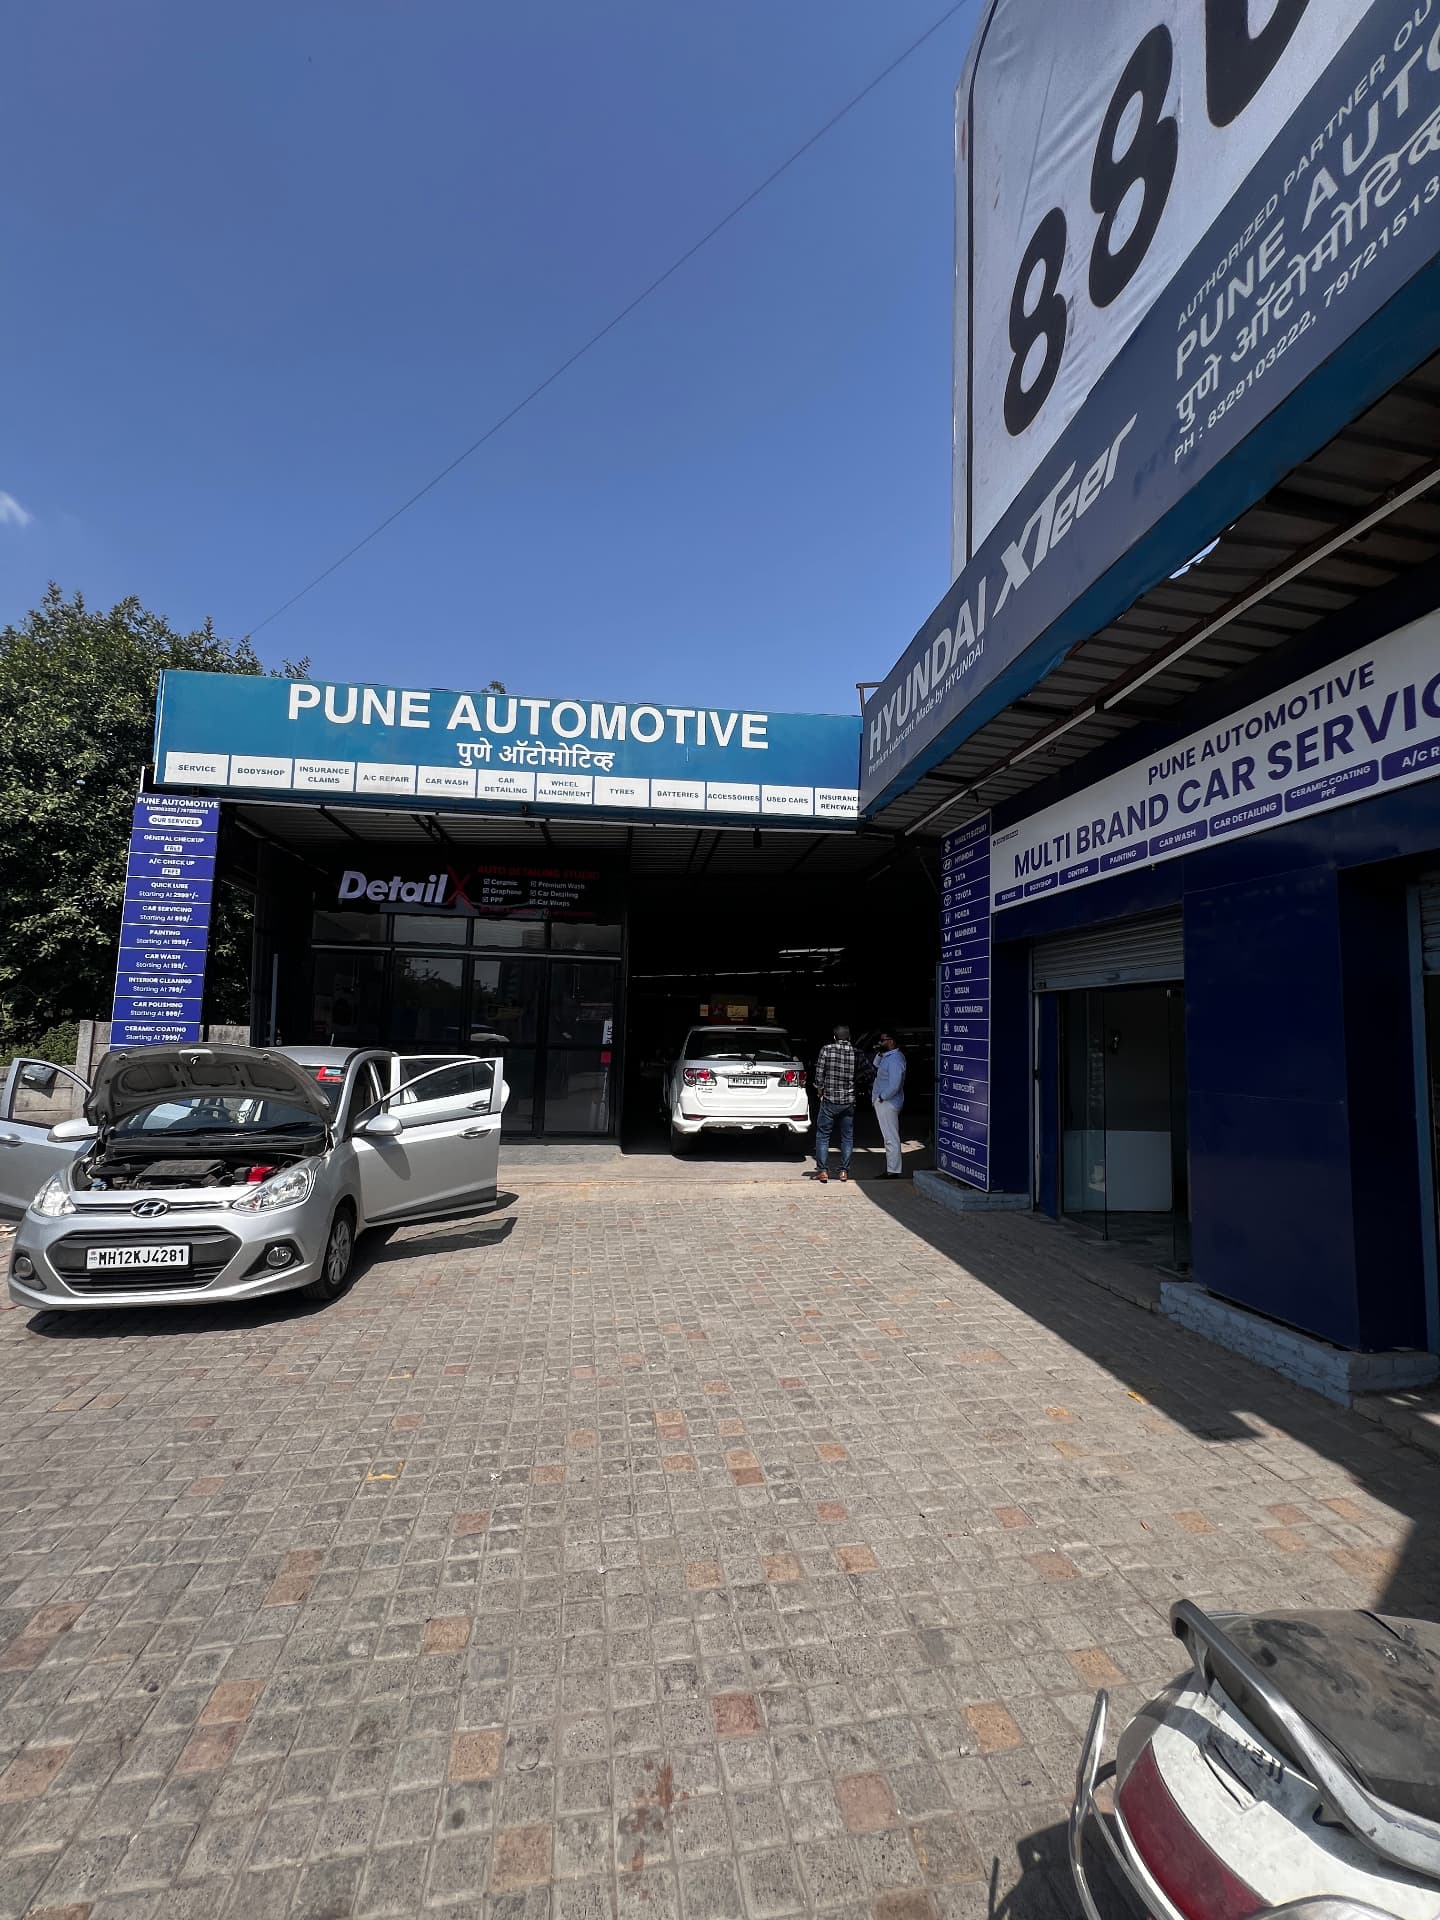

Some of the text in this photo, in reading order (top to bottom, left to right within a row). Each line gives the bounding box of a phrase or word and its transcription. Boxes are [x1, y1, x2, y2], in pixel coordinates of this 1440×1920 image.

[1177, 193, 1278, 331] AUTHORIZED
[1284, 54, 1386, 196] PARTNER
[1176, 23, 1440, 381] PUNE AUT
[1004, 0, 1311, 437] 88
[1174, 431, 1195, 465] PH
[1207, 310, 1317, 429] 8329103222,
[1176, 353, 1222, 434] पुणे
[869, 576, 987, 760] HYUNDAI
[916, 703, 935, 724] Made
[935, 687, 944, 704] by
[945, 639, 984, 689] HYUNDAI
[288, 683, 769, 750] PUNE AUTOMOTIVE
[1148, 660, 1375, 785] PUNE AUTOMOTIVE
[456, 738, 615, 772] पुणे ऑटोमोटिव्ह
[1401, 750, 1428, 768] A/C
[178, 764, 217, 773] SERVICE
[237, 767, 285, 776] BODYSHOP
[299, 766, 350, 775] INSURANCE
[307, 776, 340, 784] CLAIMS
[379, 775, 409, 783] REPAIR
[551, 780, 579, 788] WHEEL
[1290, 764, 1372, 799] CERAMIC COATING
[484, 786, 528, 794] DETAILING
[657, 790, 699, 799] BATTERIES
[707, 793, 760, 802] ACCESSORIES
[1321, 786, 1337, 799] PPF
[137, 797, 219, 808] PUNE AUTOMOTIVE
[168, 817, 199, 825] SERVICES
[1014, 831, 1070, 879] MULTI
[1077, 793, 1168, 854] BRAND
[1177, 755, 1256, 814] CAR
[1214, 802, 1277, 830] CAR DETAILING
[1159, 828, 1197, 848] CAR WASH
[1109, 850, 1137, 865] PAINTING
[139, 890, 164, 899] Starting
[955, 889, 972, 902] TOYOTA
[99, 1249, 184, 1265] MH12KJ4281
